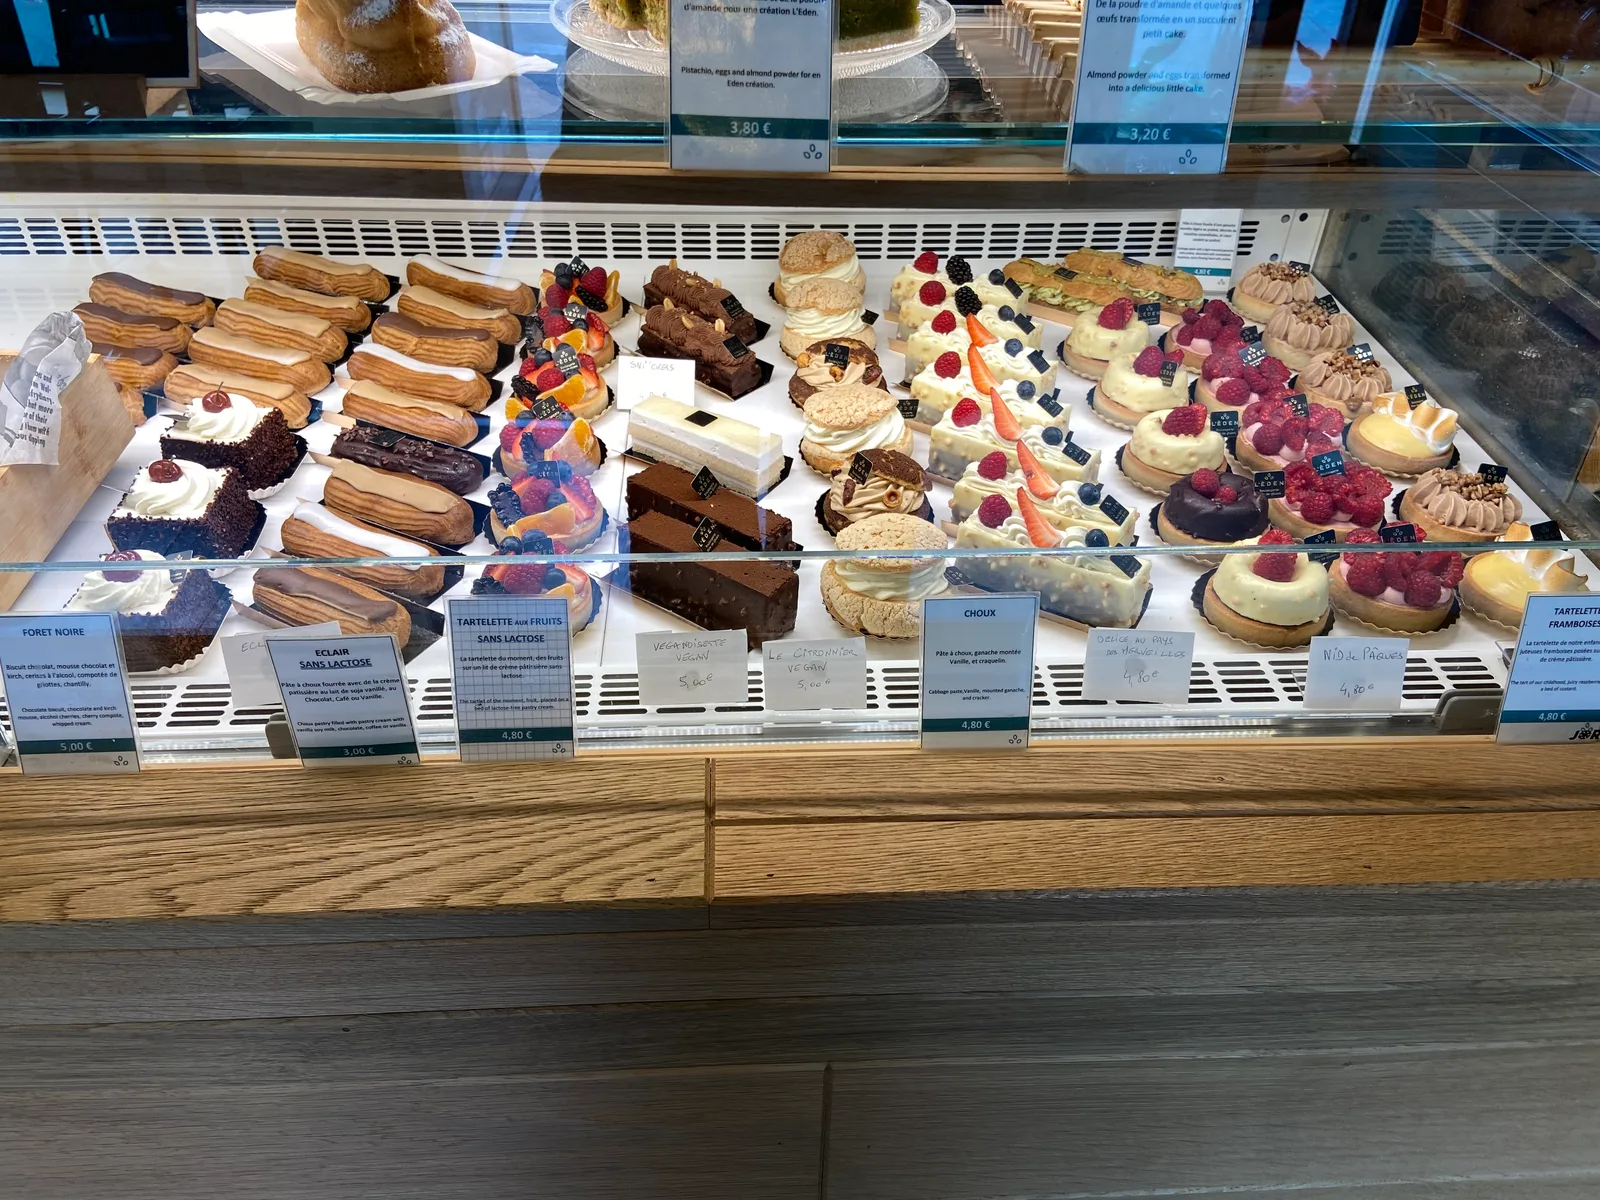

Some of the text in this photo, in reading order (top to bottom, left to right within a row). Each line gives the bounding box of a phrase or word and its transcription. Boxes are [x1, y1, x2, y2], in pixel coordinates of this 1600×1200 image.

[1096, 0, 1242, 11] De la poudre d'amande et quelques
[759, 6, 790, 15] création
[792, 7, 819, 17] L'Eden.
[1096, 14, 1118, 23] œufs
[1119, 15, 1170, 23] transformée
[1197, 15, 1237, 24] succulent
[1142, 30, 1186, 39] petit cake.
[681, 66, 714, 75] Pistachio,
[746, 69, 772, 77] almond
[773, 71, 799, 79] powder
[1087, 71, 1116, 79] Almond
[1118, 71, 1147, 80] powder
[1165, 72, 1182, 80] eggs
[727, 79, 775, 89] Eden création.
[1108, 84, 1124, 92] into
[1131, 84, 1165, 92] delicious
[1166, 84, 1184, 92] little
[1185, 85, 1204, 93] cake.
[730, 121, 771, 136] 3,80 €
[1129, 128, 1171, 143] 3,20 €
[964, 609, 996, 618] CHOUX
[457, 618, 513, 626] TARTELETTE
[22, 628, 85, 637] FORET NOIRE
[477, 634, 544, 643] SANS LACTOSE
[1152, 636, 1173, 646] PAYS
[241, 642, 266, 652] ECL
[315, 648, 350, 657] ECLAIR
[676, 650, 710, 662] VEGAN
[974, 649, 998, 657] ganache
[1346, 651, 1358, 661] de
[299, 658, 372, 669] SANS LACTOSE
[788, 661, 827, 673] VEGAN
[322, 680, 346, 688] fourrée
[1538, 712, 1567, 722] 4,80 €
[962, 720, 991, 730] 4,80 €
[502, 731, 532, 740] 4,80 €
[60, 742, 93, 752] 5,00 €
[343, 747, 375, 757] 3,00 €
